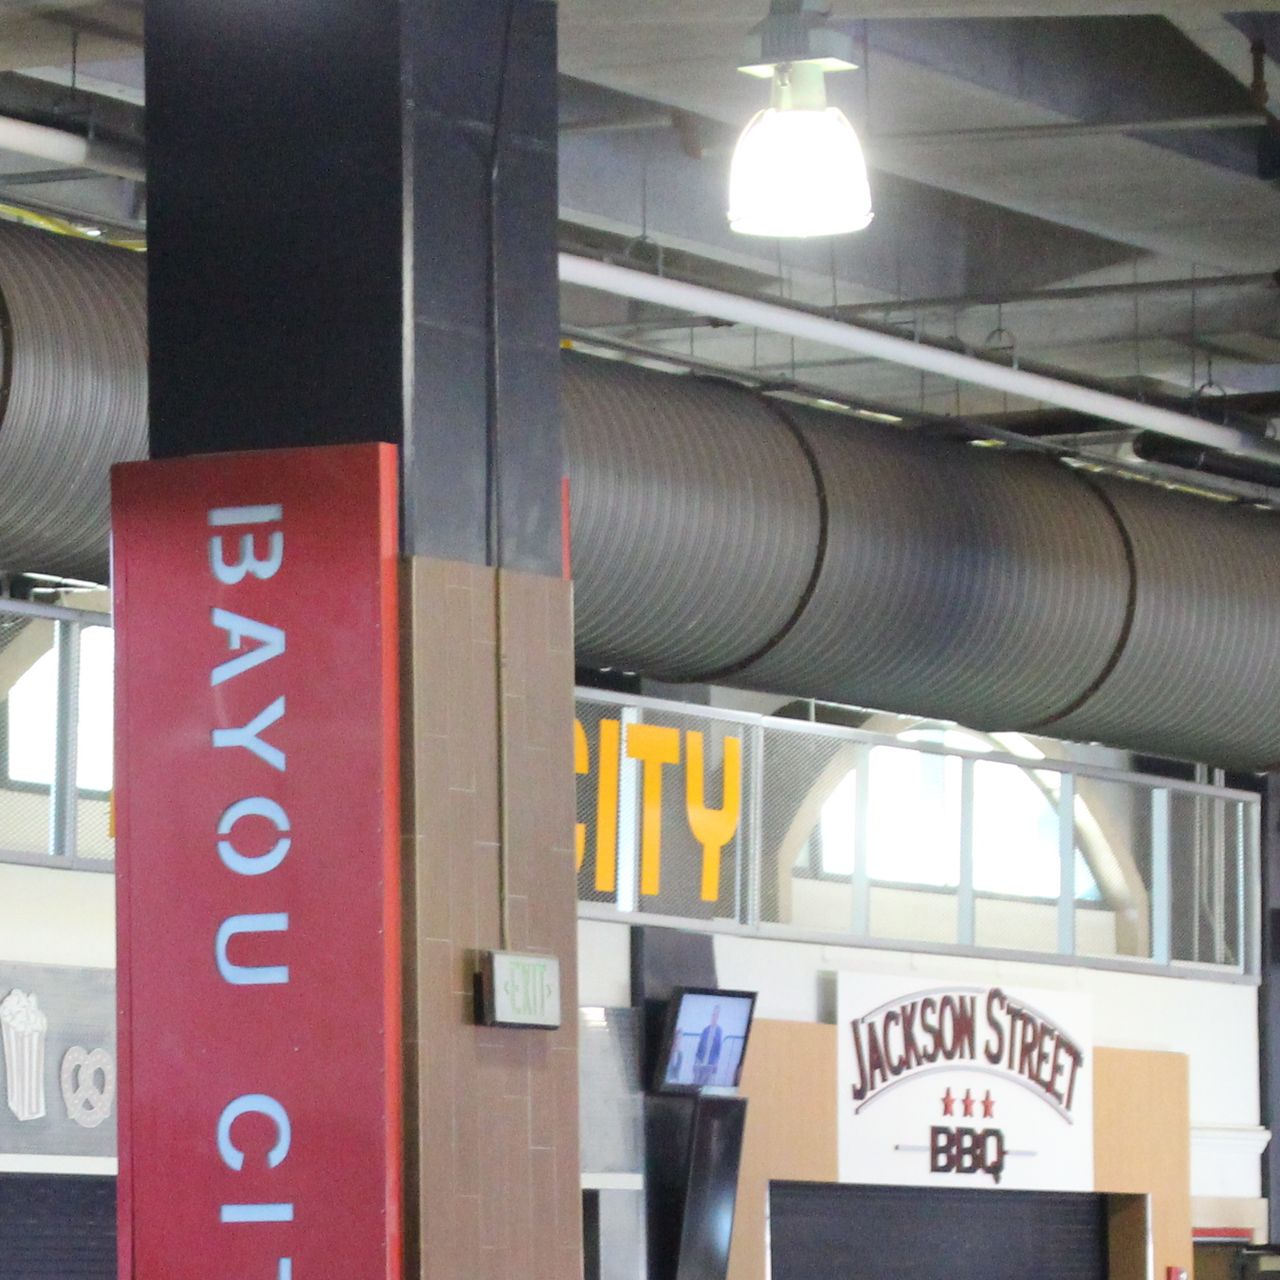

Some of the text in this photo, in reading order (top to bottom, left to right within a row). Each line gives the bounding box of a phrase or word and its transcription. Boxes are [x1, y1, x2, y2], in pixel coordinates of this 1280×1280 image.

[206, 503, 292, 986] BAYOU
[509, 960, 545, 1017] EXIT
[850, 987, 1085, 1112] JACKSON STREET
[929, 1125, 1006, 1184] BBQ
